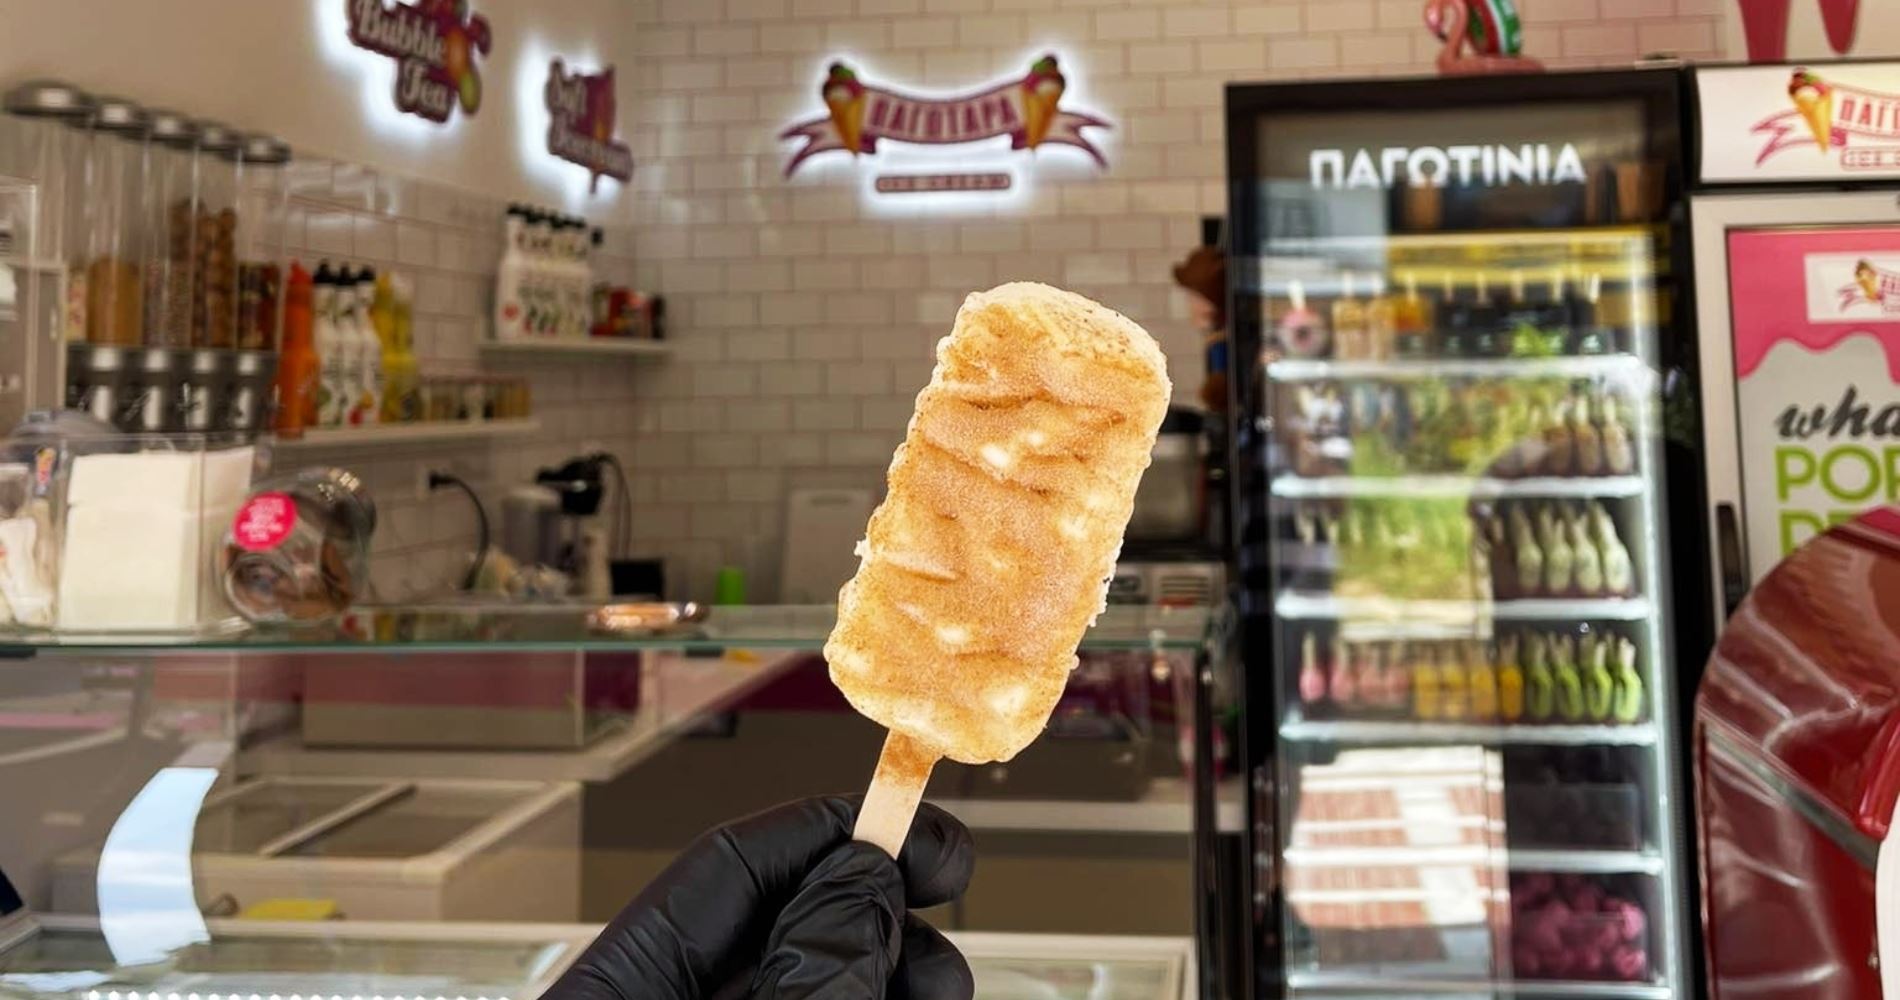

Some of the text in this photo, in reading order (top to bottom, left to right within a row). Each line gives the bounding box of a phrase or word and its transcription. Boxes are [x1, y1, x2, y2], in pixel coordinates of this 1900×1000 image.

[353, 0, 447, 64] Bubble
[402, 59, 449, 114] Tea
[1309, 142, 1588, 190] ΠΑΓΩΤΙΝΙΑ
